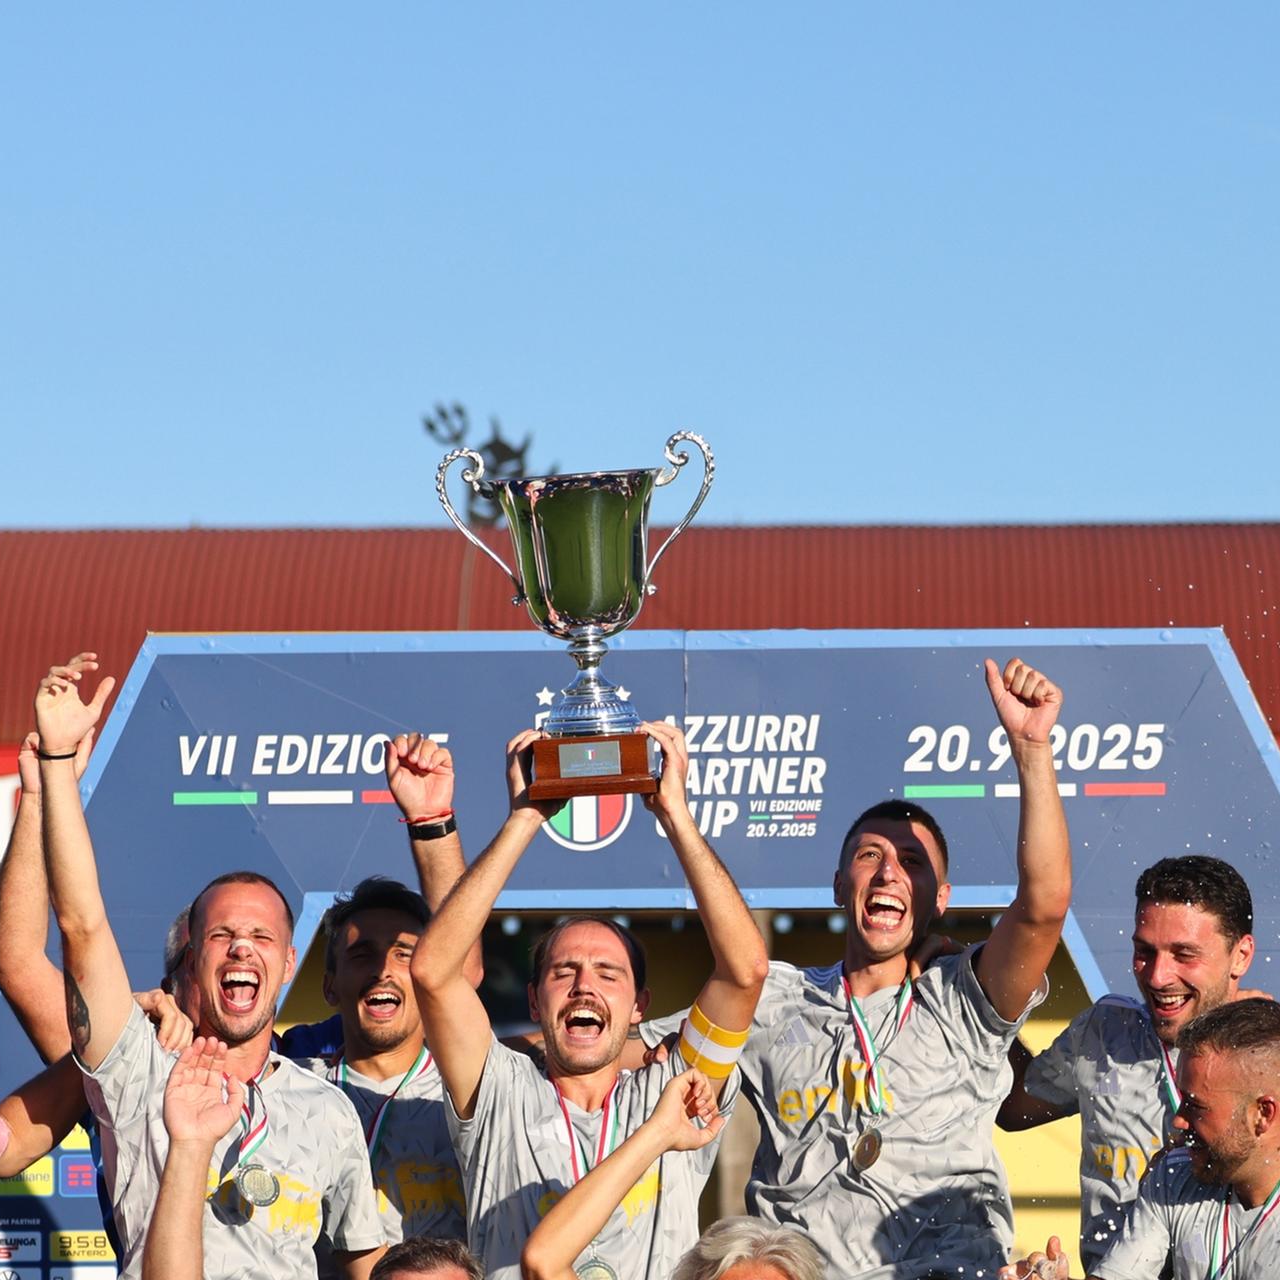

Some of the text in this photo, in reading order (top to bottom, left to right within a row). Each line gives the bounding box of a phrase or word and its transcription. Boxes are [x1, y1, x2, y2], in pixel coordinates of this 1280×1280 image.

[178, 733, 449, 776] VII EDIZIO
[903, 723, 1165, 773] 20.92025
[659, 757, 827, 795] ARTNER
[749, 799, 823, 812] VII EDIZIONE
[746, 823, 817, 838] 20.9.2025
[11, 1218, 41, 1226] PARTNER
[59, 1250, 107, 1258] SANTERO
